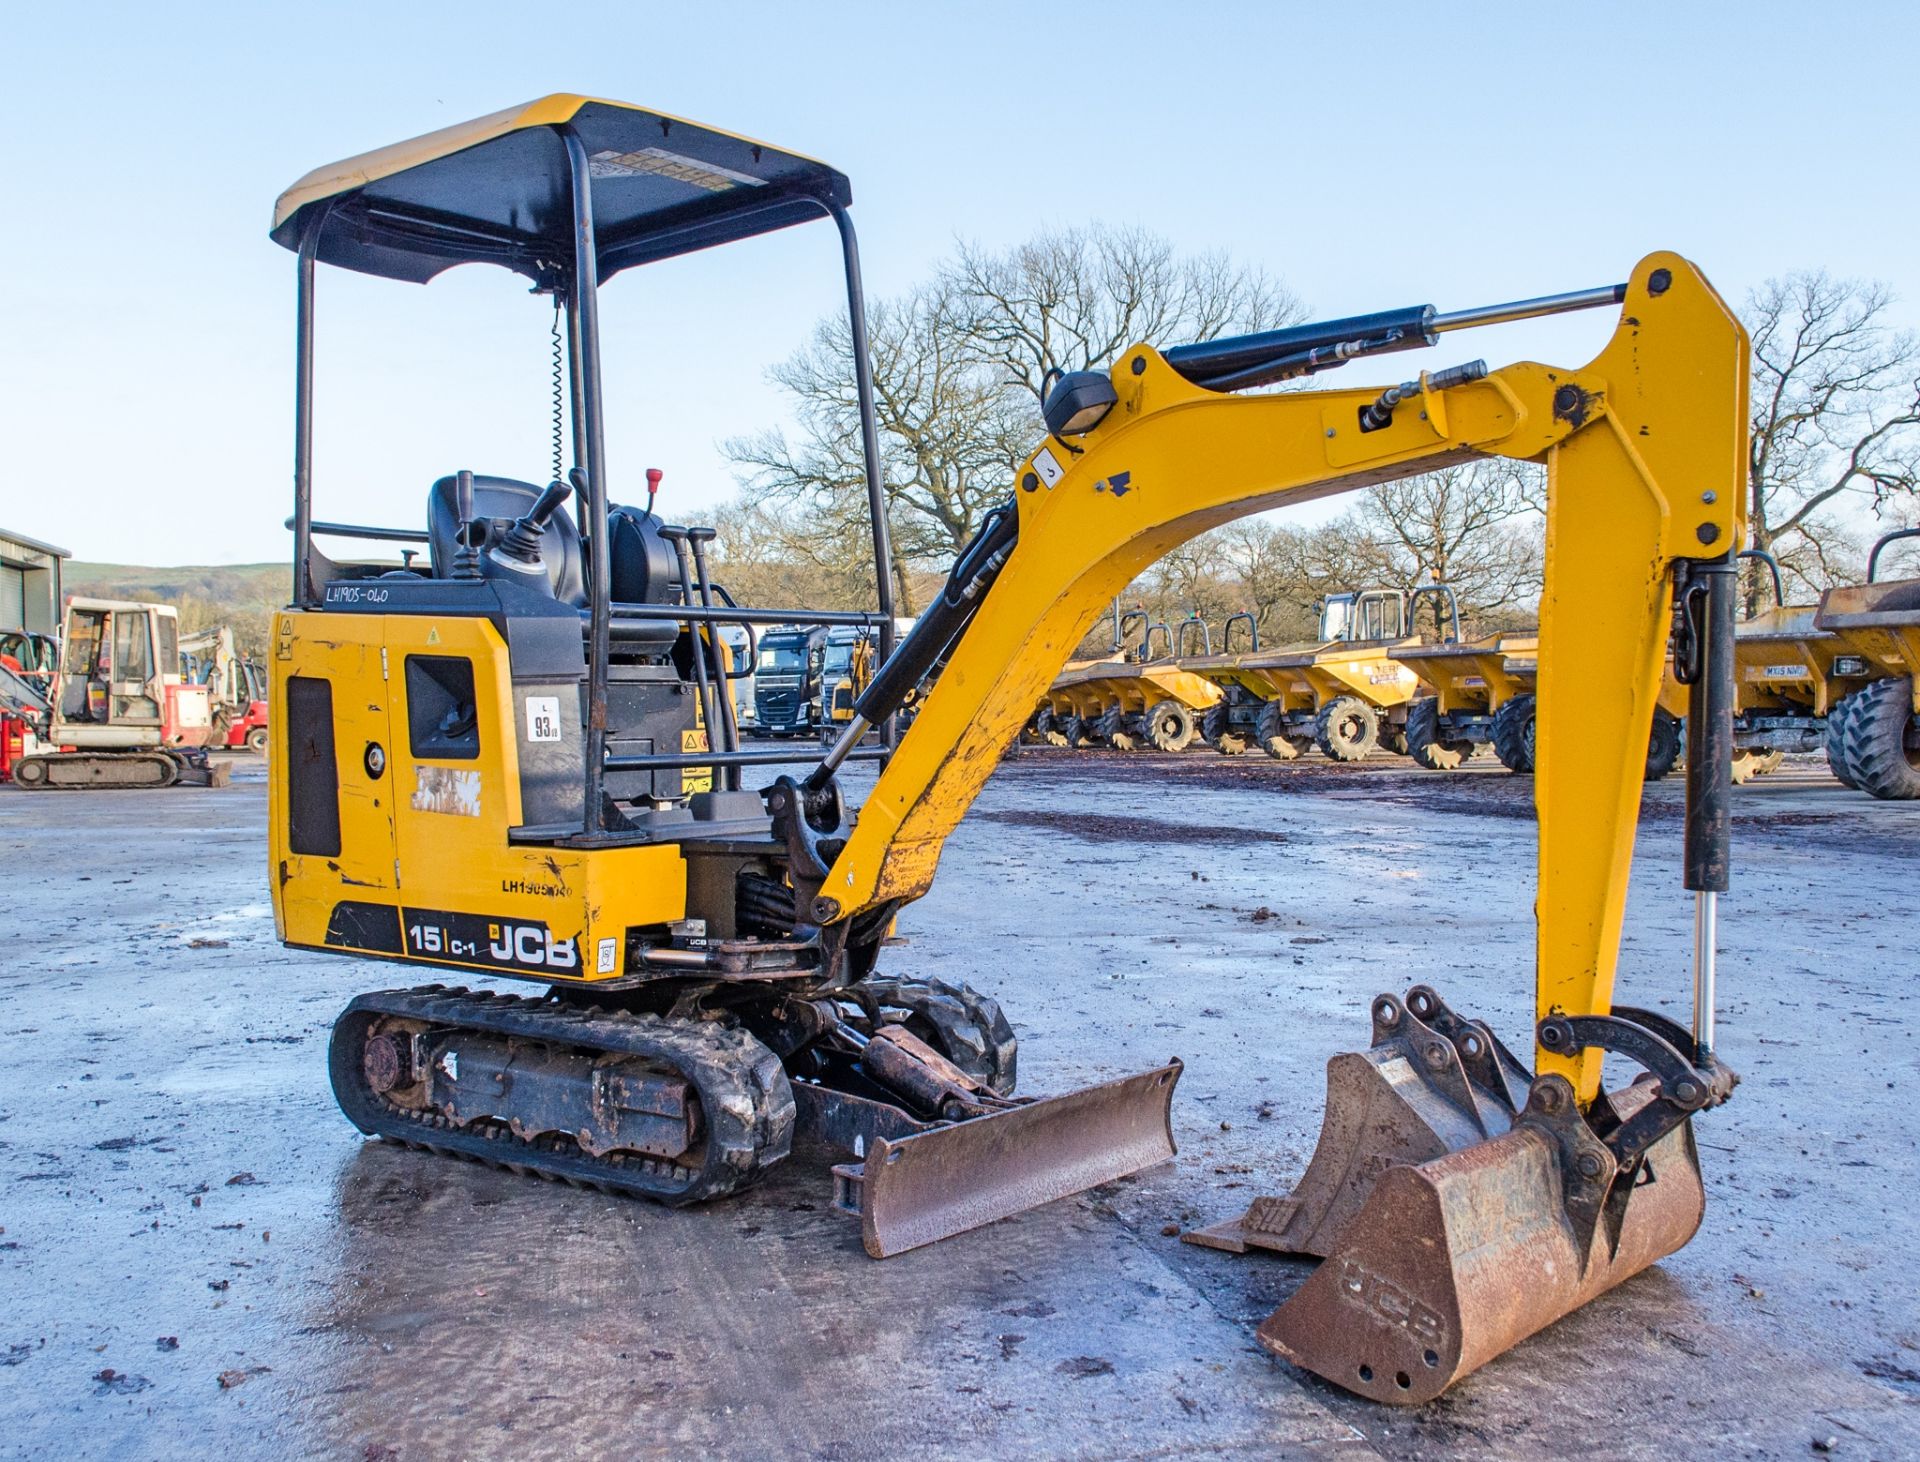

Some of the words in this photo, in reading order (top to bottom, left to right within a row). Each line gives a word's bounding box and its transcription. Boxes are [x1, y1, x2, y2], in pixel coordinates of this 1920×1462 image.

[326, 587, 389, 602] LH1905-040
[535, 716, 550, 738] 93
[410, 925, 441, 952] 15
[489, 924, 577, 968] JCB
